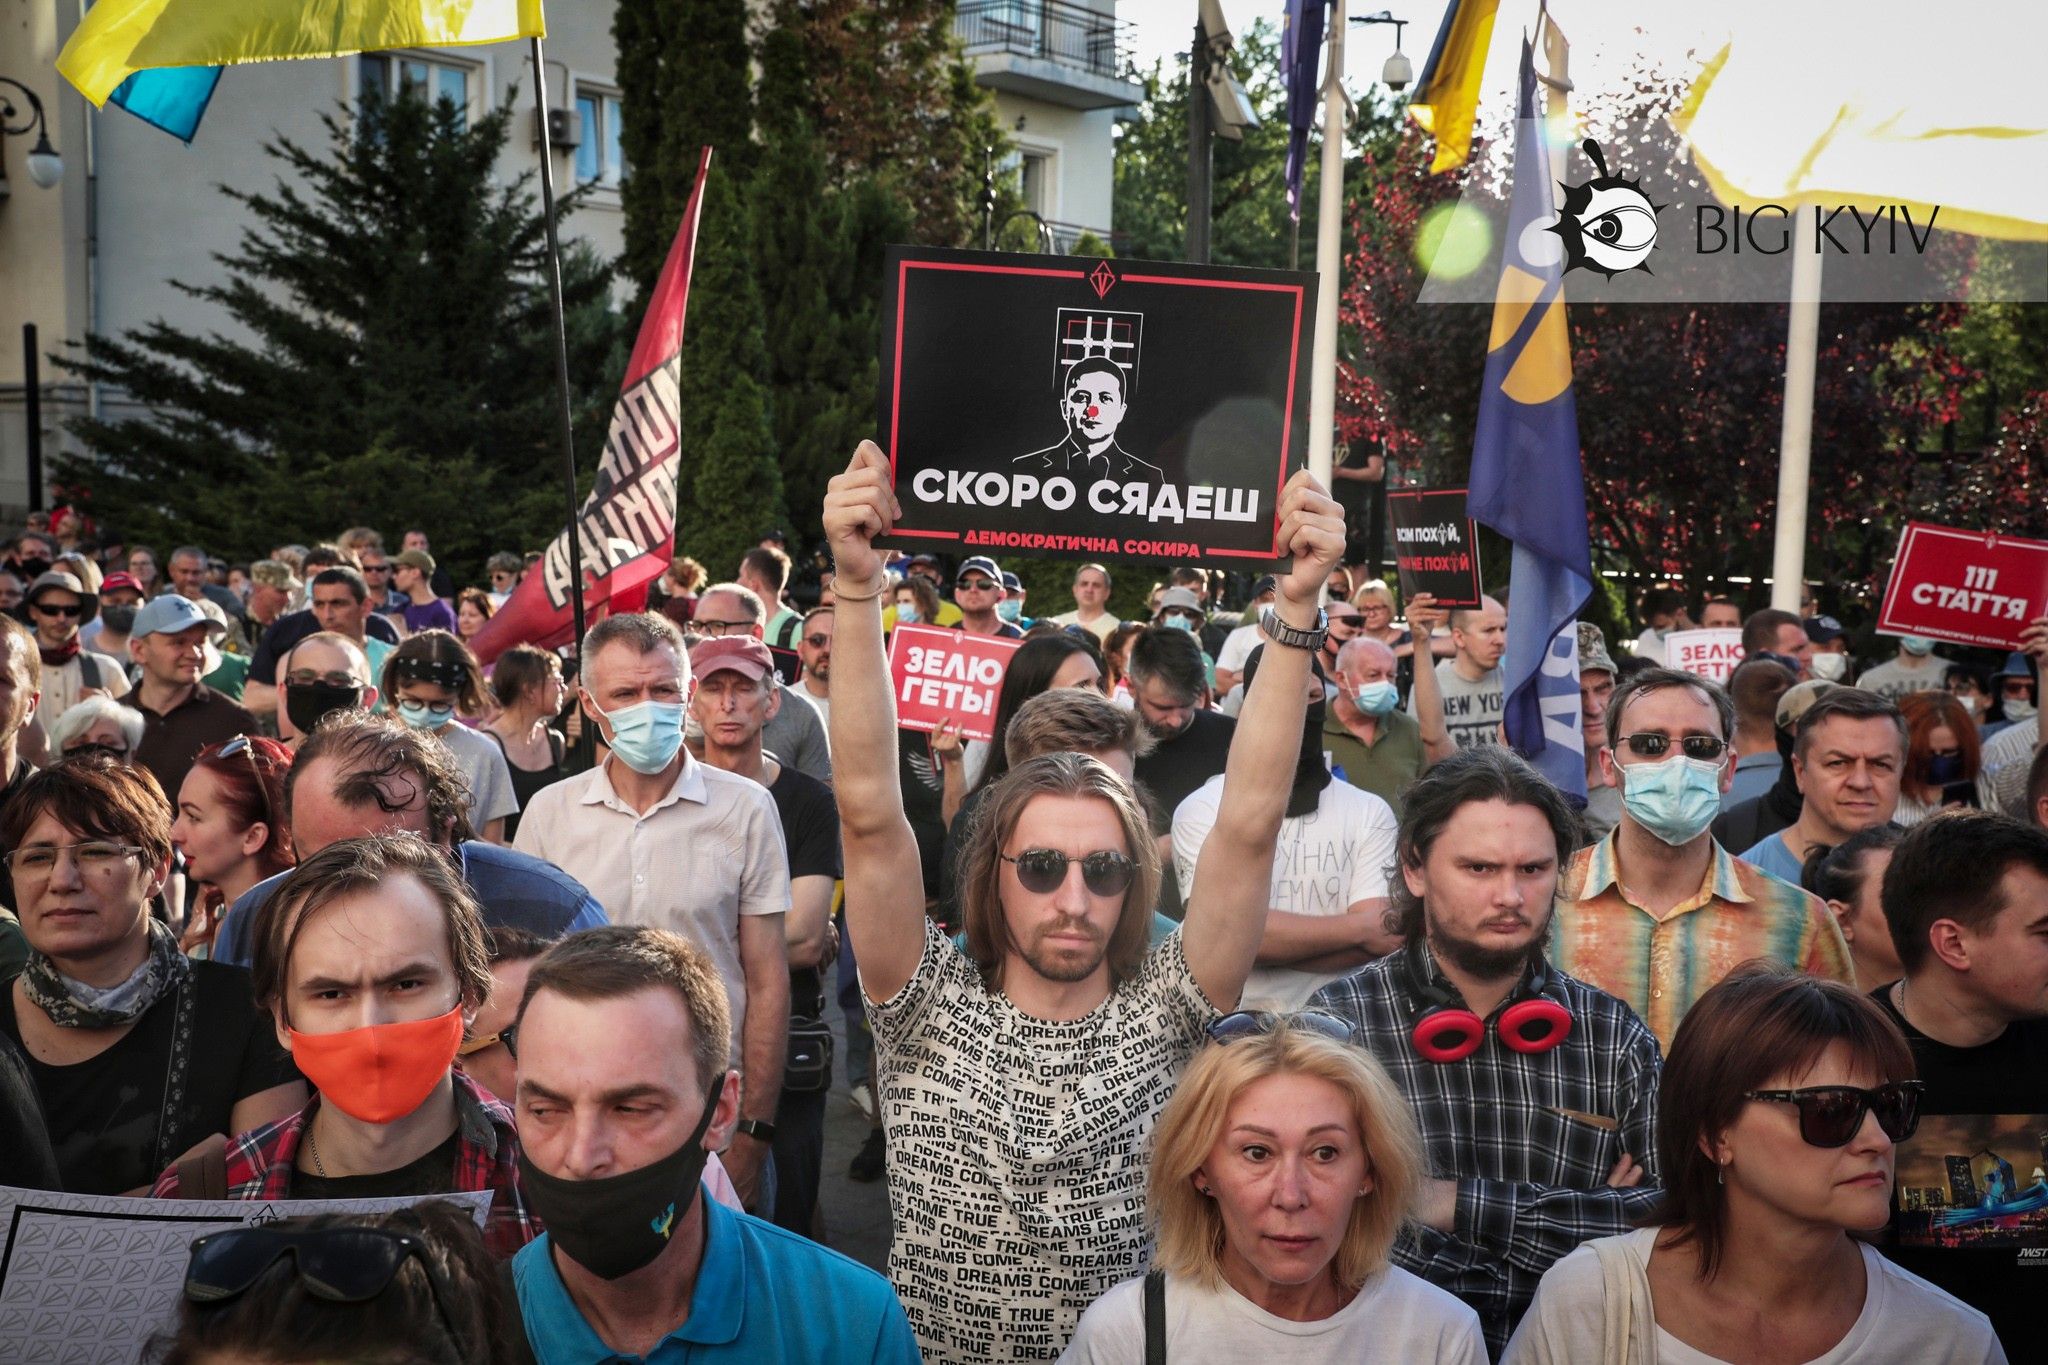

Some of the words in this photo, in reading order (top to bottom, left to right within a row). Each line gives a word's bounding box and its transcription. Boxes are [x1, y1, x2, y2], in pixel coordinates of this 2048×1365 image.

[912, 467, 1077, 511] СКОРО
[1087, 481, 1260, 524] СЯДЕШ
[963, 529, 1120, 555] ДЕМОКРАТИЧНА
[1123, 538, 1201, 558] СОКИРА
[1911, 582, 2029, 621] СТАТТЯ
[904, 646, 1003, 686] ЗЕЛЮ
[1681, 643, 1746, 662] ЗЕЛЮ
[901, 676, 995, 716] ГЕТЬ!
[922, 1023, 984, 1063] DREAMS
[922, 1065, 966, 1093] COME
[970, 1086, 1005, 1116] TRUE
[1013, 1088, 1056, 1109] TRUE
[950, 1106, 1010, 1142] DREAMS
[1053, 1105, 1121, 1155] DREAMS
[1122, 1074, 1163, 1110] COME
[889, 1123, 947, 1140] DREAMS
[994, 1140, 1033, 1161] TRUE
[896, 1150, 954, 1179] DREAMS
[1032, 1155, 1084, 1174] COME
[1091, 1141, 1133, 1163] TRUE
[1070, 1171, 1144, 1201] DREAMS
[954, 1208, 999, 1229] TRUE
[1020, 1220, 1092, 1239] DREAMS
[1097, 1212, 1145, 1233] COME
[905, 1243, 967, 1265] DREAMS
[940, 1222, 988, 1250] COME
[995, 1239, 1040, 1259] TRUE
[891, 1253, 949, 1283] DREAMS
[1060, 1252, 1133, 1269] DREAMS
[957, 1267, 1033, 1288] DREAMS
[1039, 1275, 1091, 1292] COME
[954, 1299, 1002, 1320] COME
[1009, 1308, 1055, 1323] TRUE
[951, 1335, 992, 1357] TRUE
